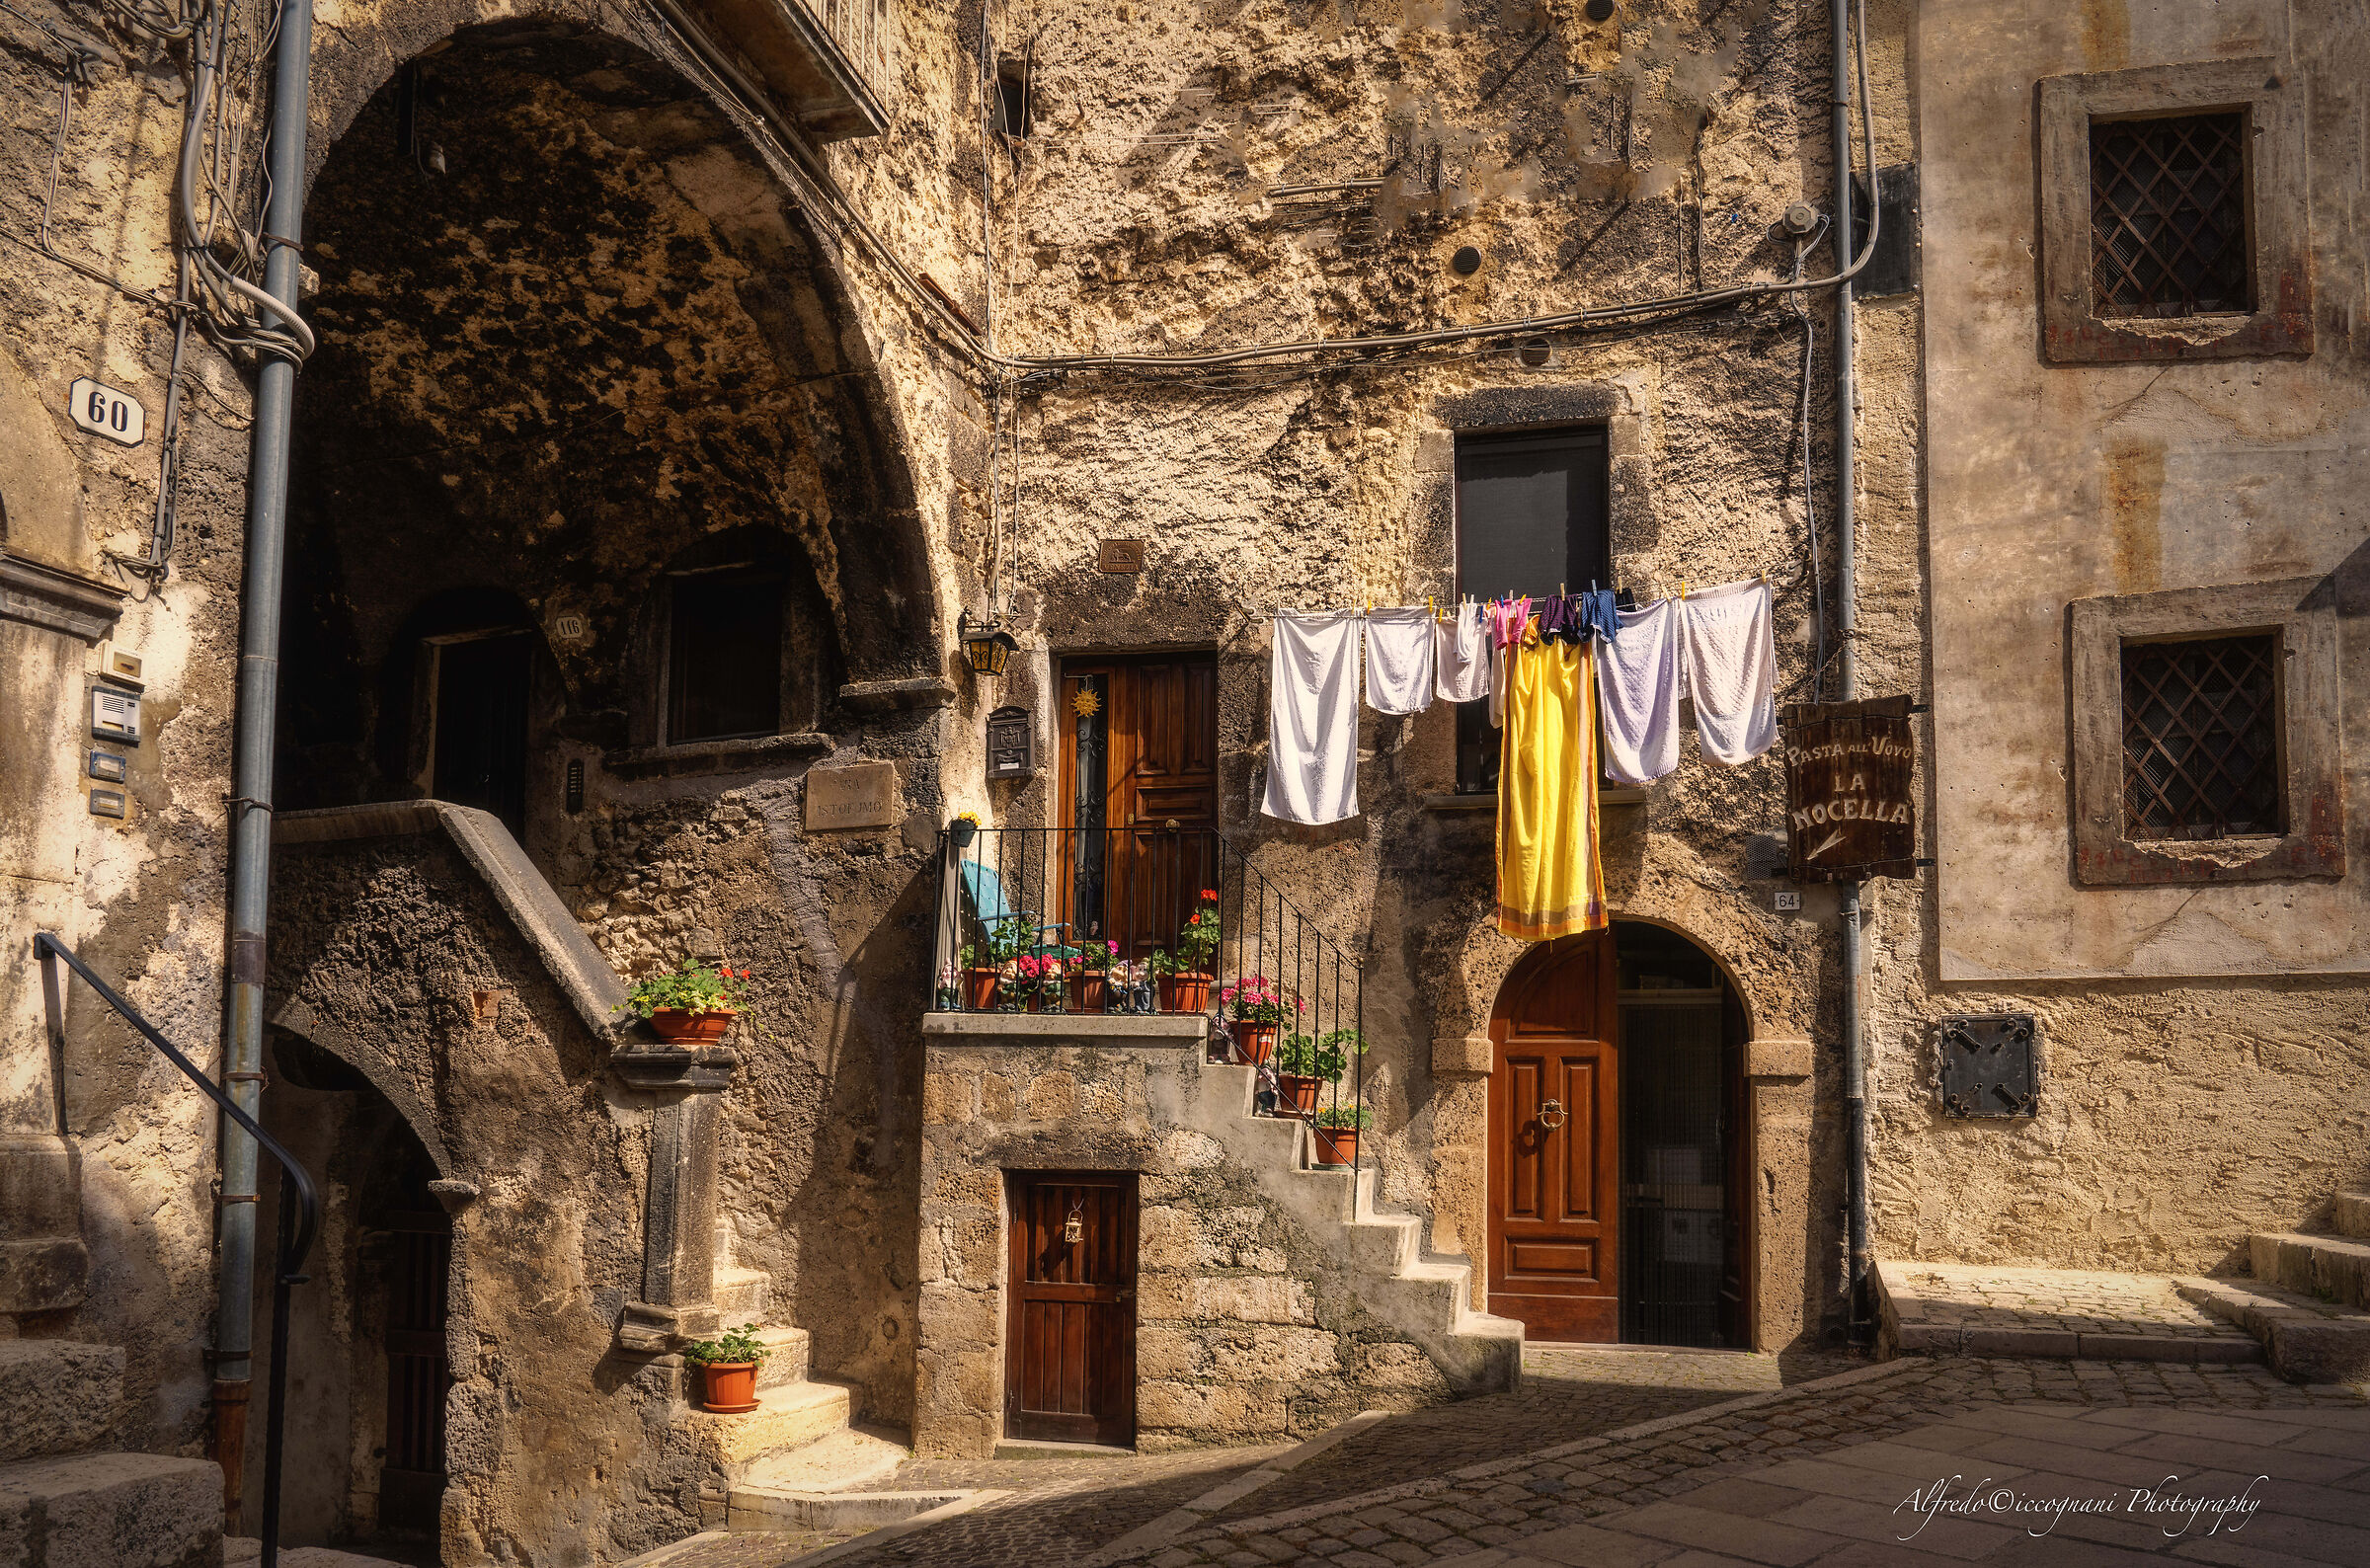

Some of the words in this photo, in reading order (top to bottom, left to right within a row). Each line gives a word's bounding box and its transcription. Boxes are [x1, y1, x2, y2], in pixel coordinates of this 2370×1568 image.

[88, 391, 128, 432] 60
[560, 619, 580, 635] 116
[1785, 743, 1846, 767] PASTA
[1834, 773, 1865, 792] LA
[1791, 798, 1911, 831] NOCELLA
[1778, 895, 1795, 907] 64
